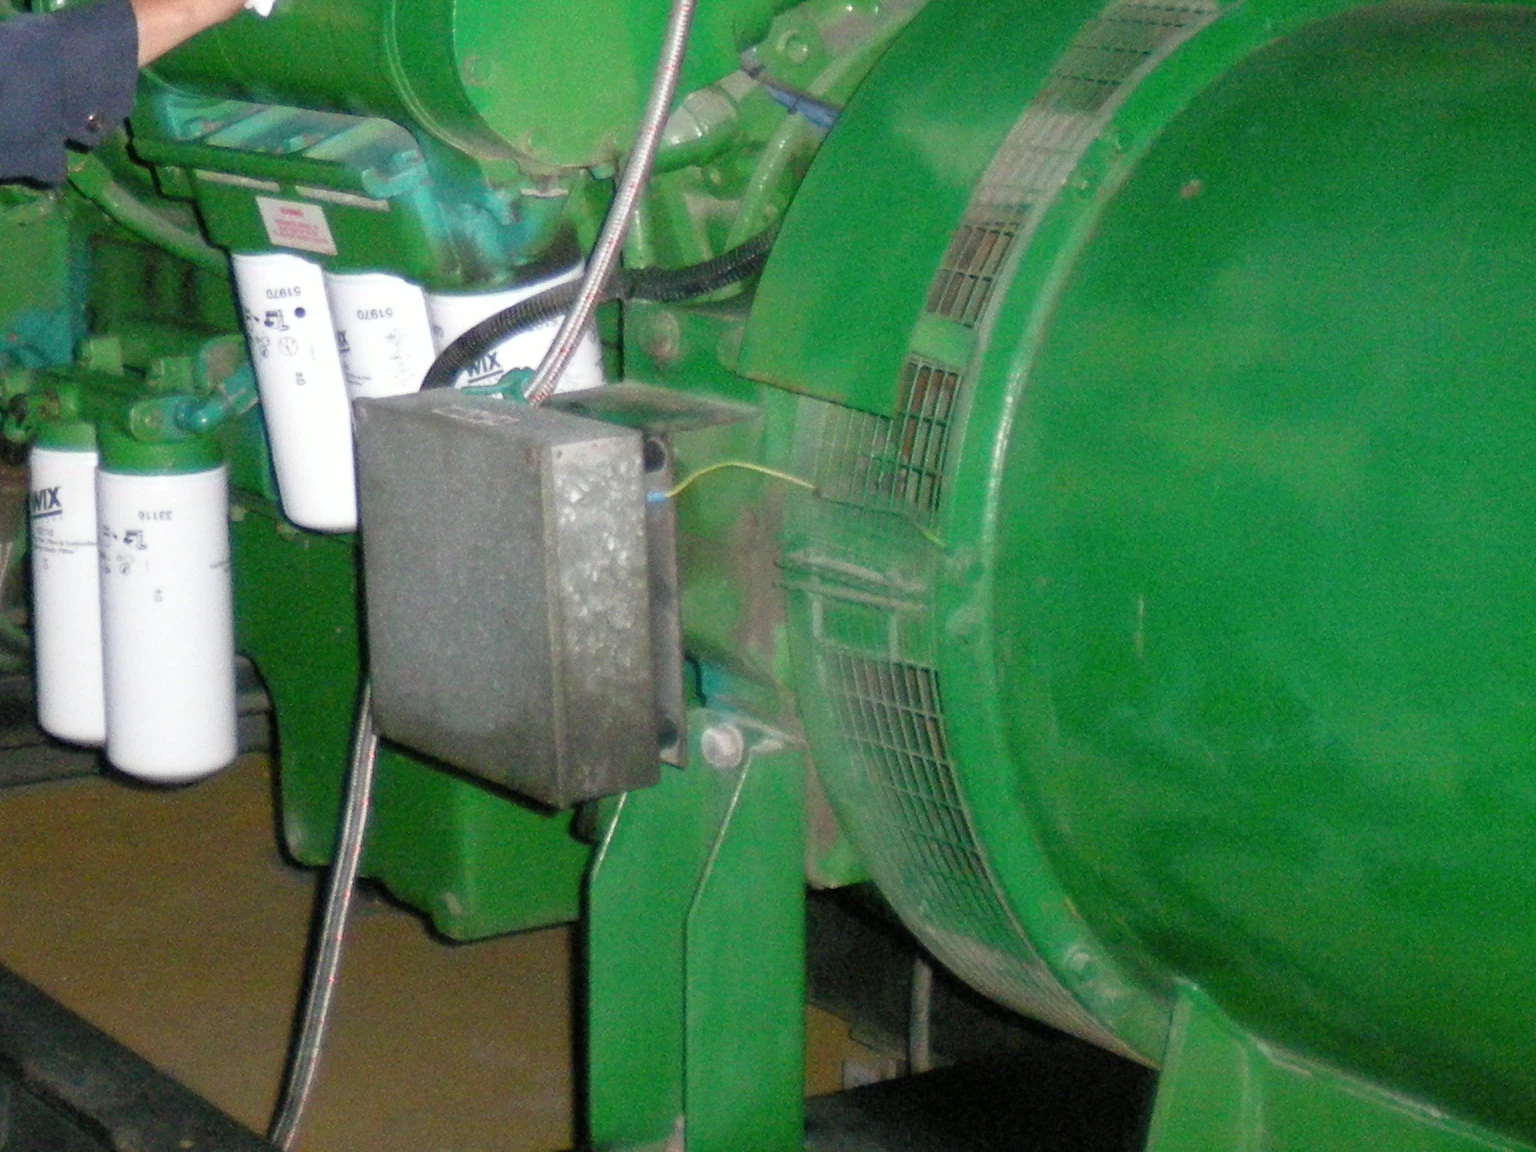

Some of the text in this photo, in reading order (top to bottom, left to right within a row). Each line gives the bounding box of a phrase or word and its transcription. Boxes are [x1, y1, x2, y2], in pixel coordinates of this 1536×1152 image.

[266, 285, 302, 299] 51970
[357, 307, 394, 321] 51970
[31, 486, 63, 512] WIX
